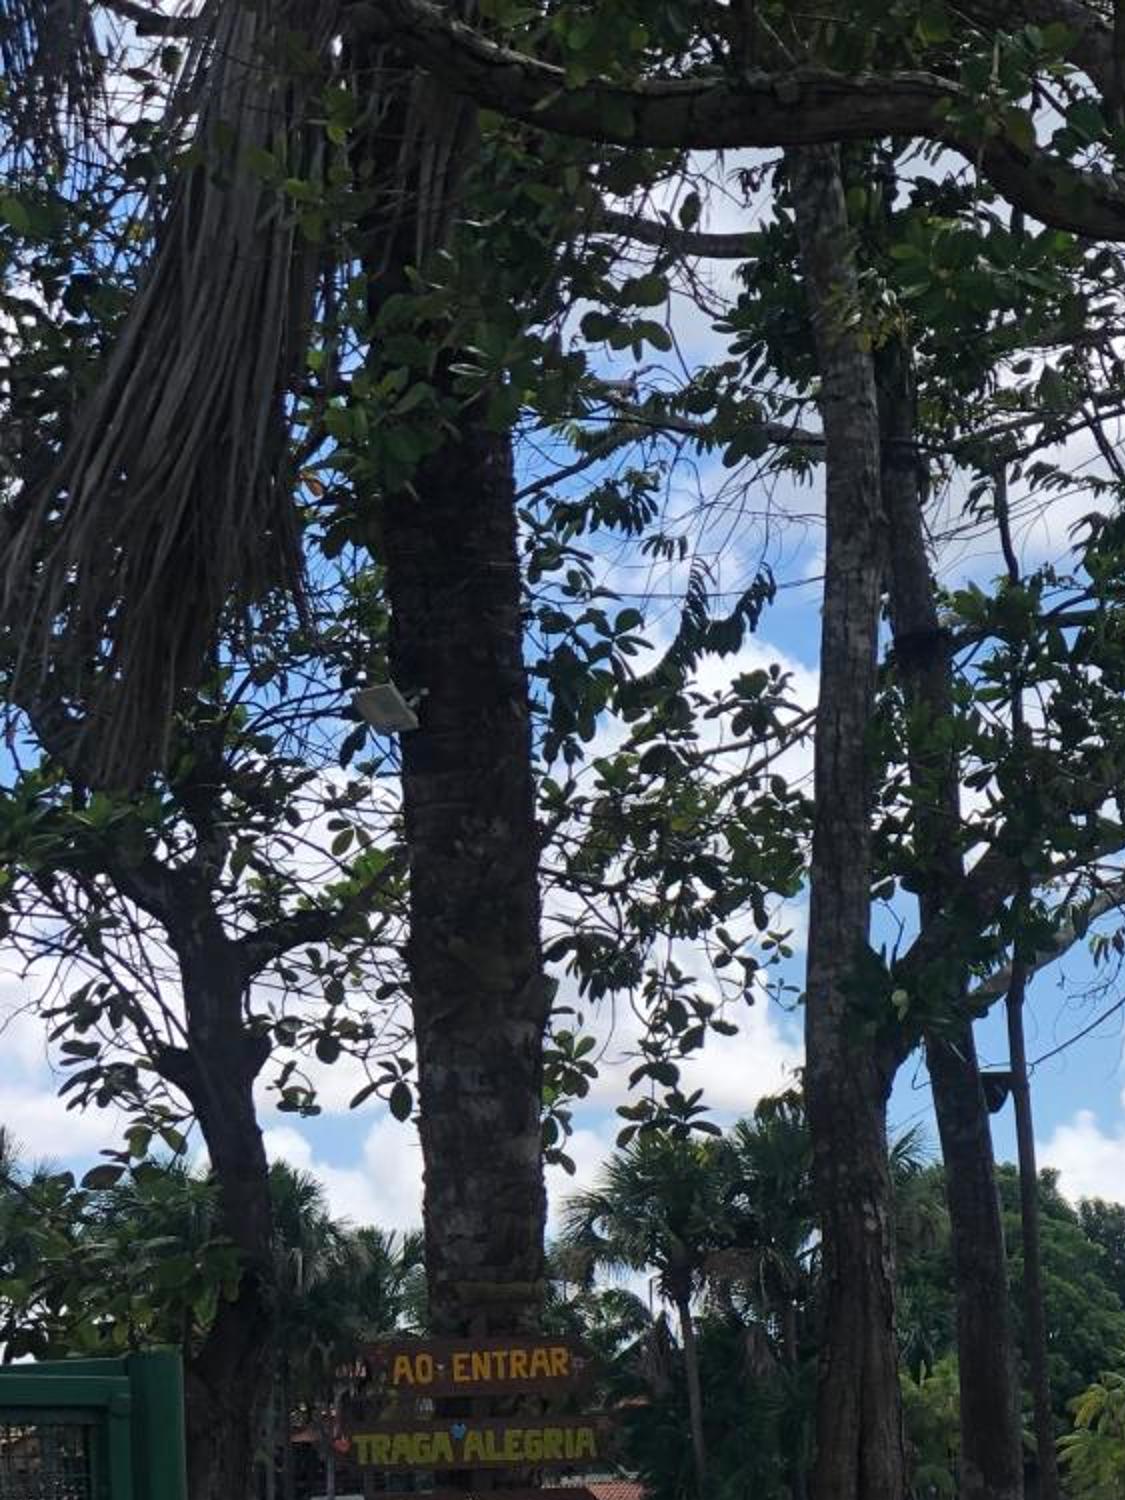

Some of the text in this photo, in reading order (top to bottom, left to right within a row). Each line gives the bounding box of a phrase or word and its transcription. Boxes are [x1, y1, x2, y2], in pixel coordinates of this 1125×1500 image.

[393, 1348, 571, 1385] AO ENTRAR
[351, 1427, 597, 1465] TRAGA ALEGRIA
